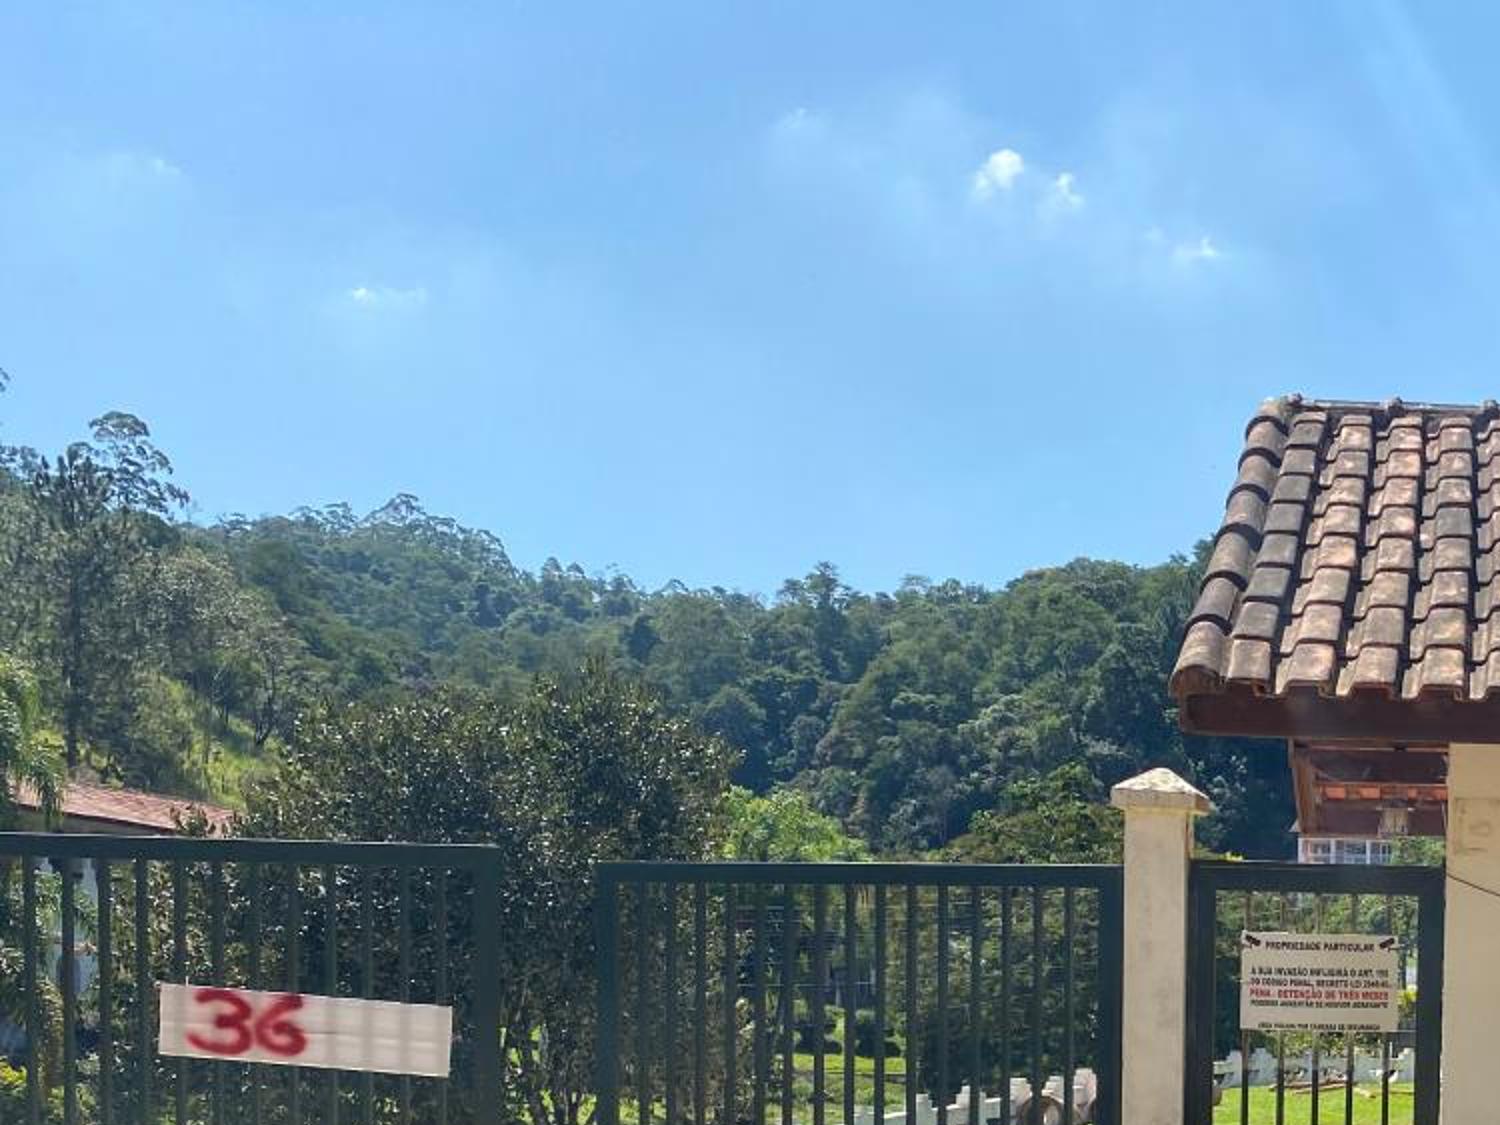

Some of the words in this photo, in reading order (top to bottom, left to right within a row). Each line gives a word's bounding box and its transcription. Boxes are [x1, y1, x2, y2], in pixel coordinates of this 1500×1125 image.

[1265, 941, 1321, 951] PROPRIEDADE
[1323, 942, 1375, 952] PARTICULAR
[185, 988, 307, 1057] 36
